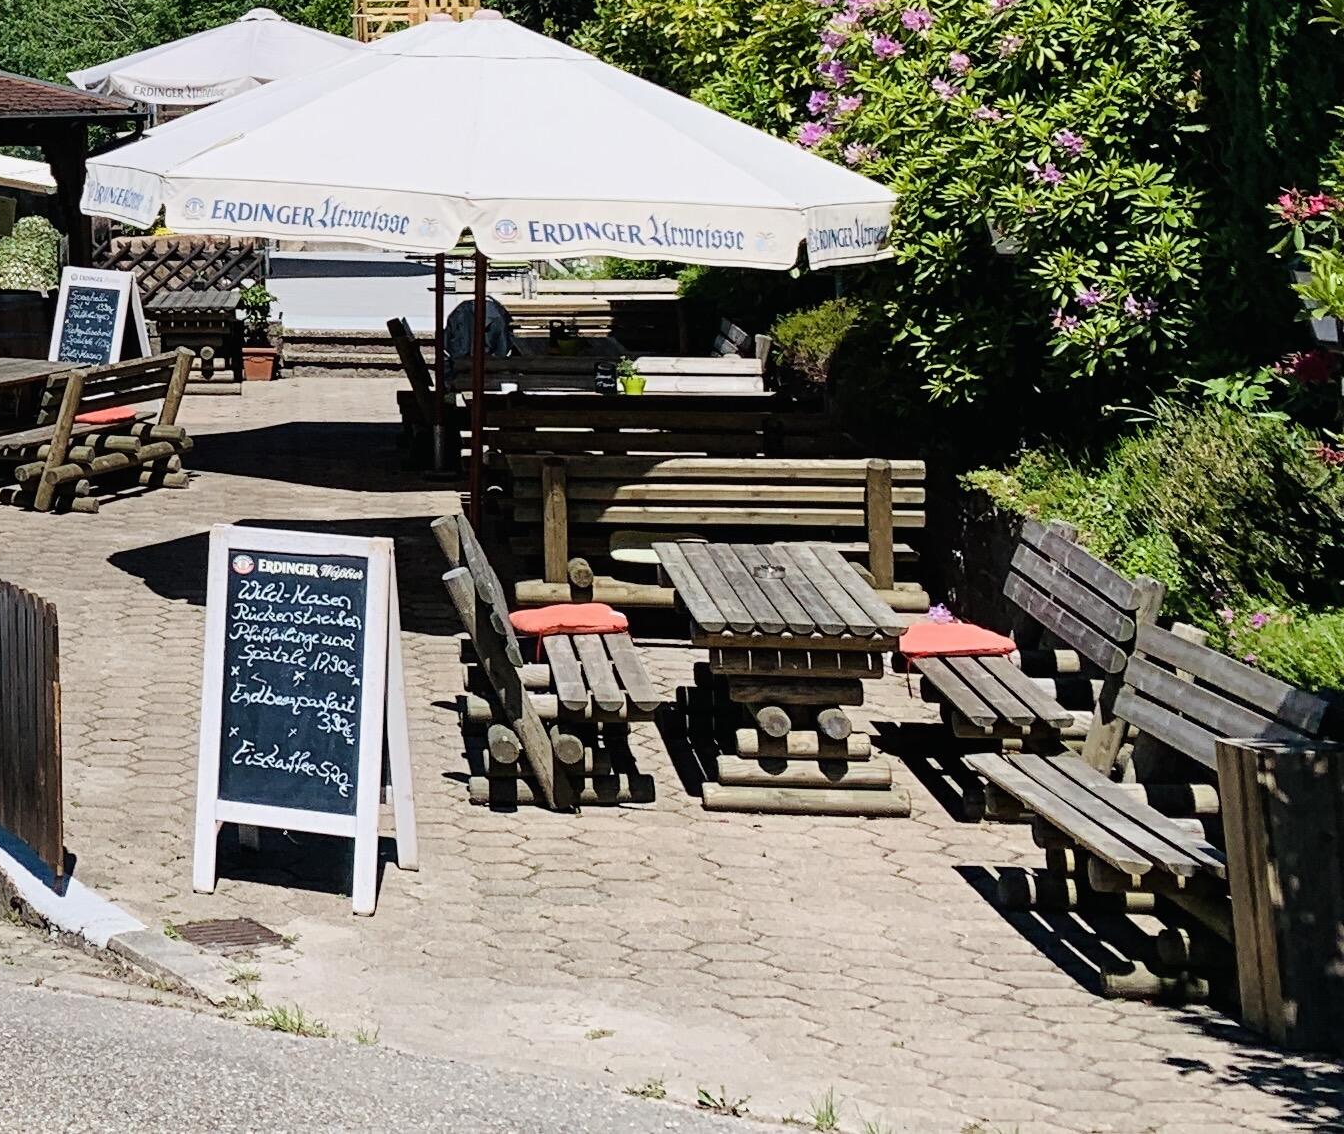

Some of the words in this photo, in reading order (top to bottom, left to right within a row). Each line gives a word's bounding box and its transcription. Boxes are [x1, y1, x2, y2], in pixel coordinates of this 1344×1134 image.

[132, 85, 184, 99] ERDINGER
[211, 199, 315, 228] ERDINGER
[318, 196, 410, 236] Urweisse
[528, 220, 646, 246] ERDINGER
[648, 213, 745, 250] Urweisse
[258, 558, 319, 578] ERDINGER
[320, 564, 364, 581] Weißbier
[320, 632, 355, 651] und
[237, 644, 308, 667] Spätzle
[232, 739, 317, 776] Eiskaffee
